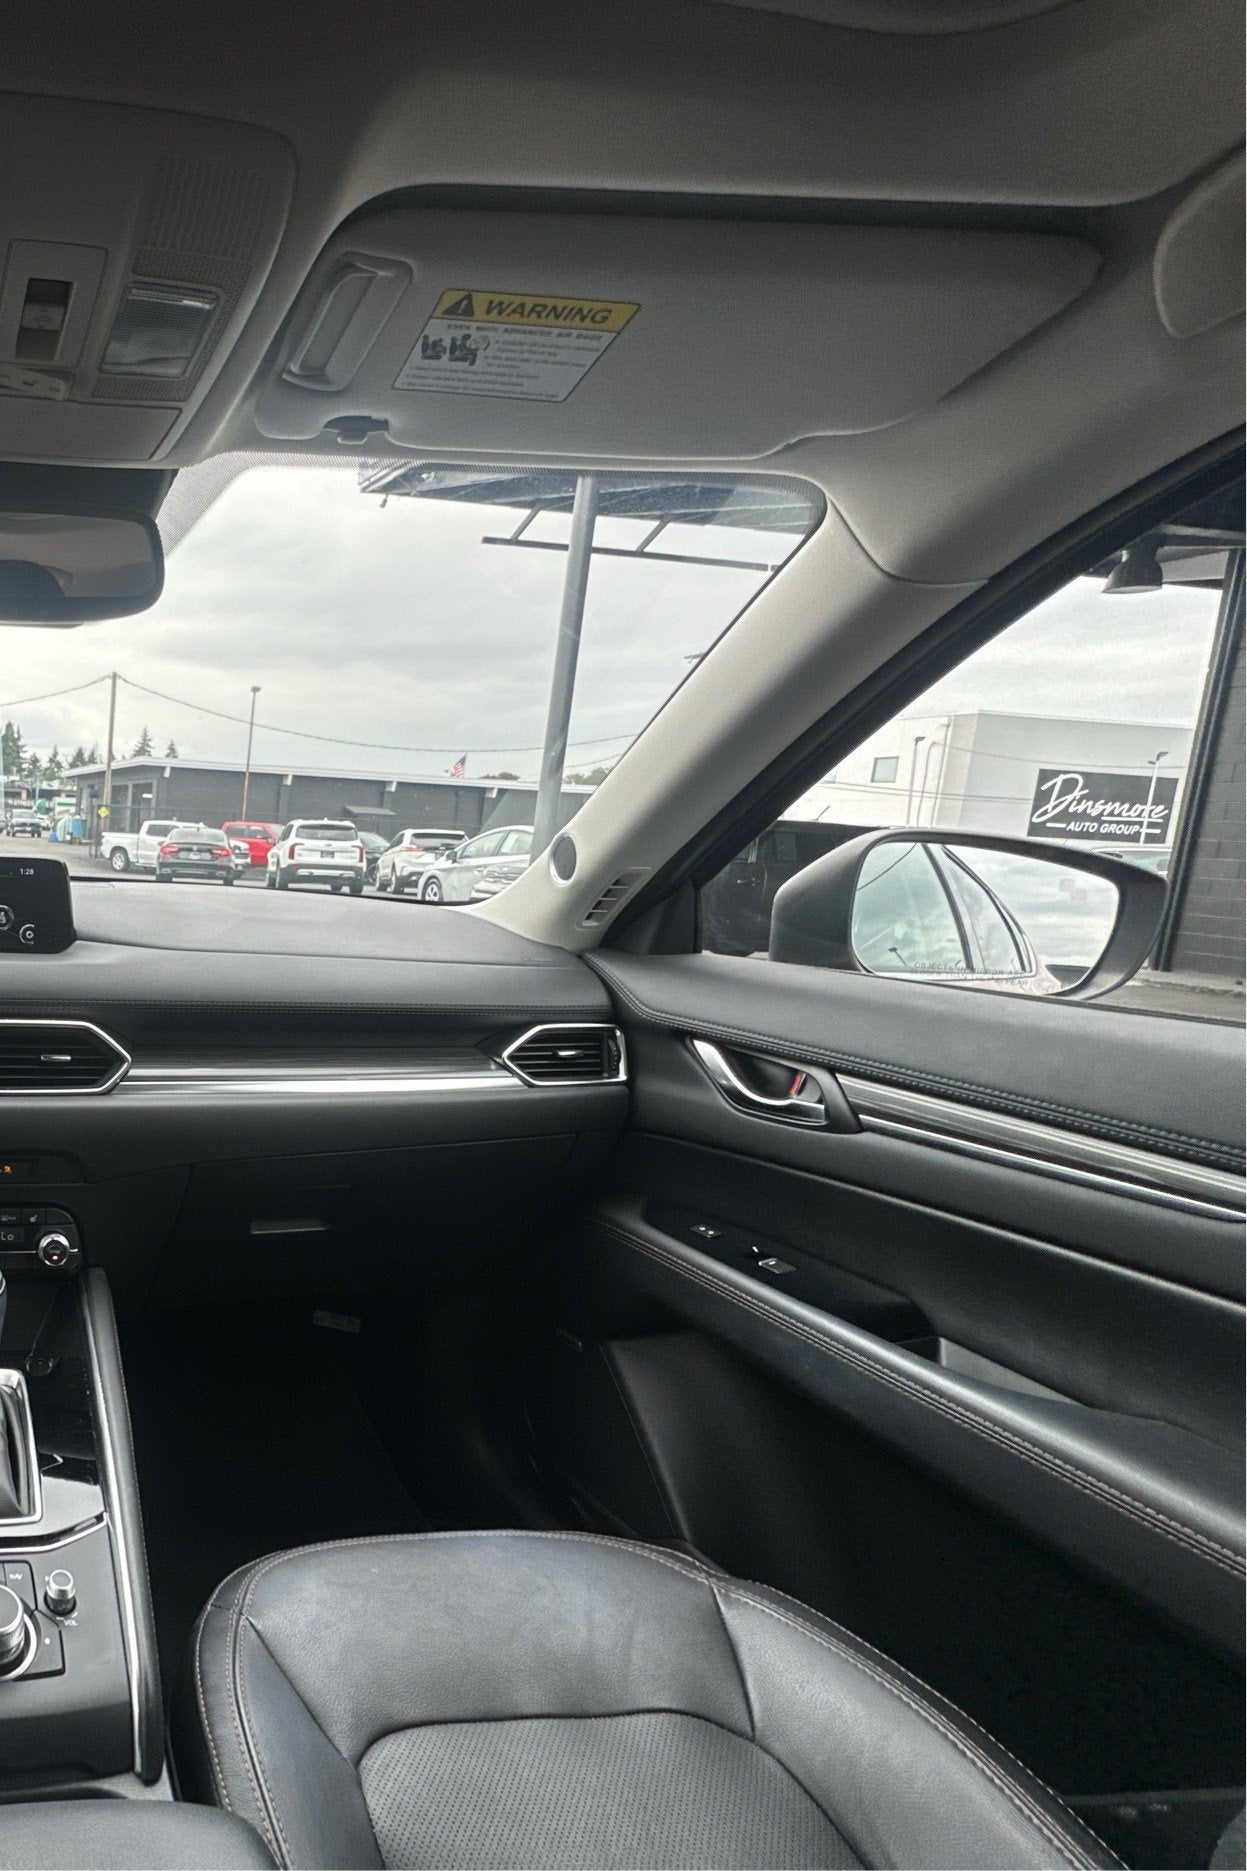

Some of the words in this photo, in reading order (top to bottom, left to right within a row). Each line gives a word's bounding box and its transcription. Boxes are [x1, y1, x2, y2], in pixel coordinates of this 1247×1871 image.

[485, 299, 612, 325] WARNING
[1032, 773, 1169, 823] Dinsmore
[1066, 821, 1097, 833] AUTO
[1099, 823, 1140, 835] GROUP
[20, 868, 34, 876] 1:28
